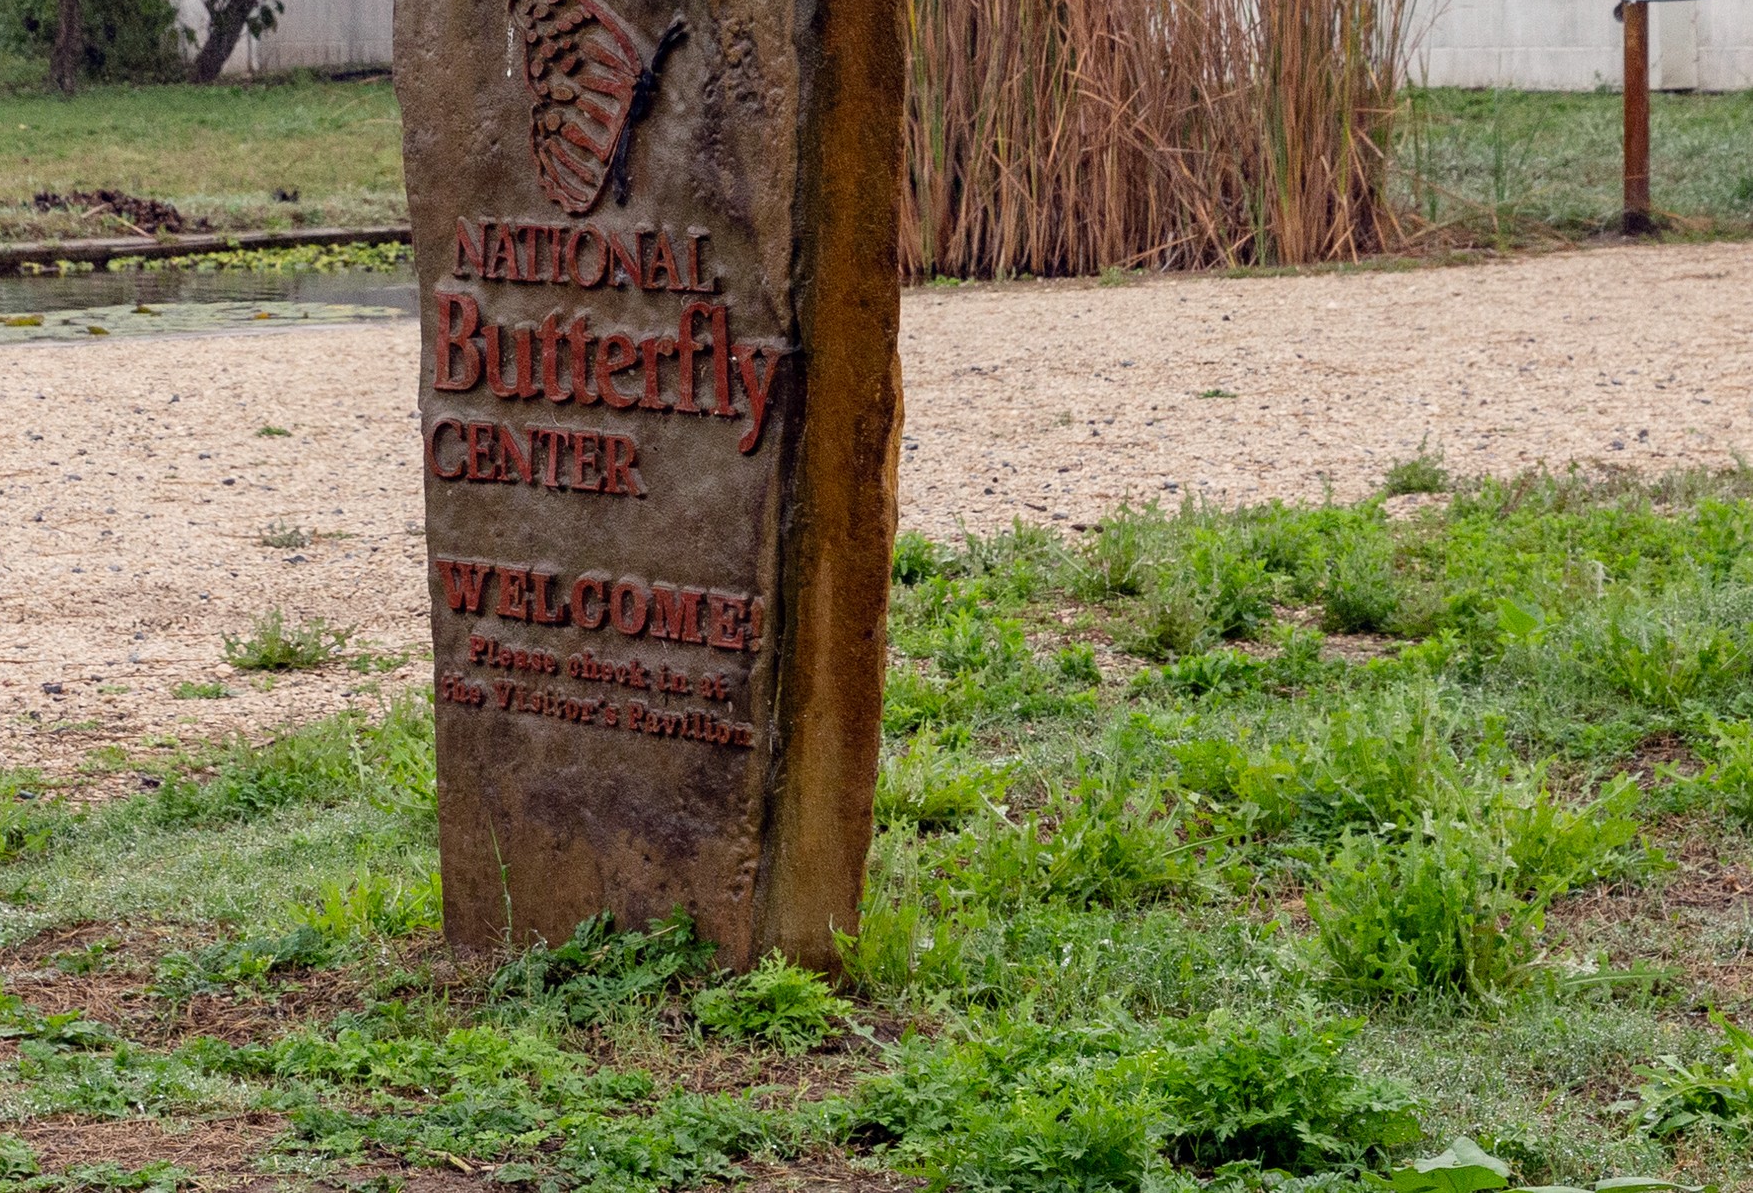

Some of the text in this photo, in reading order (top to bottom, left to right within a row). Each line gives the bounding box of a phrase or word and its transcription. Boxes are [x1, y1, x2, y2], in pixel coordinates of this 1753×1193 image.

[452, 216, 718, 293] NATIONAL
[433, 288, 784, 455] Butterfly
[424, 417, 646, 499] CENTER
[435, 556, 766, 653] WELCOME!
[468, 633, 728, 701] Please check in at
[441, 673, 756, 749] the Visitor's Pavilion
